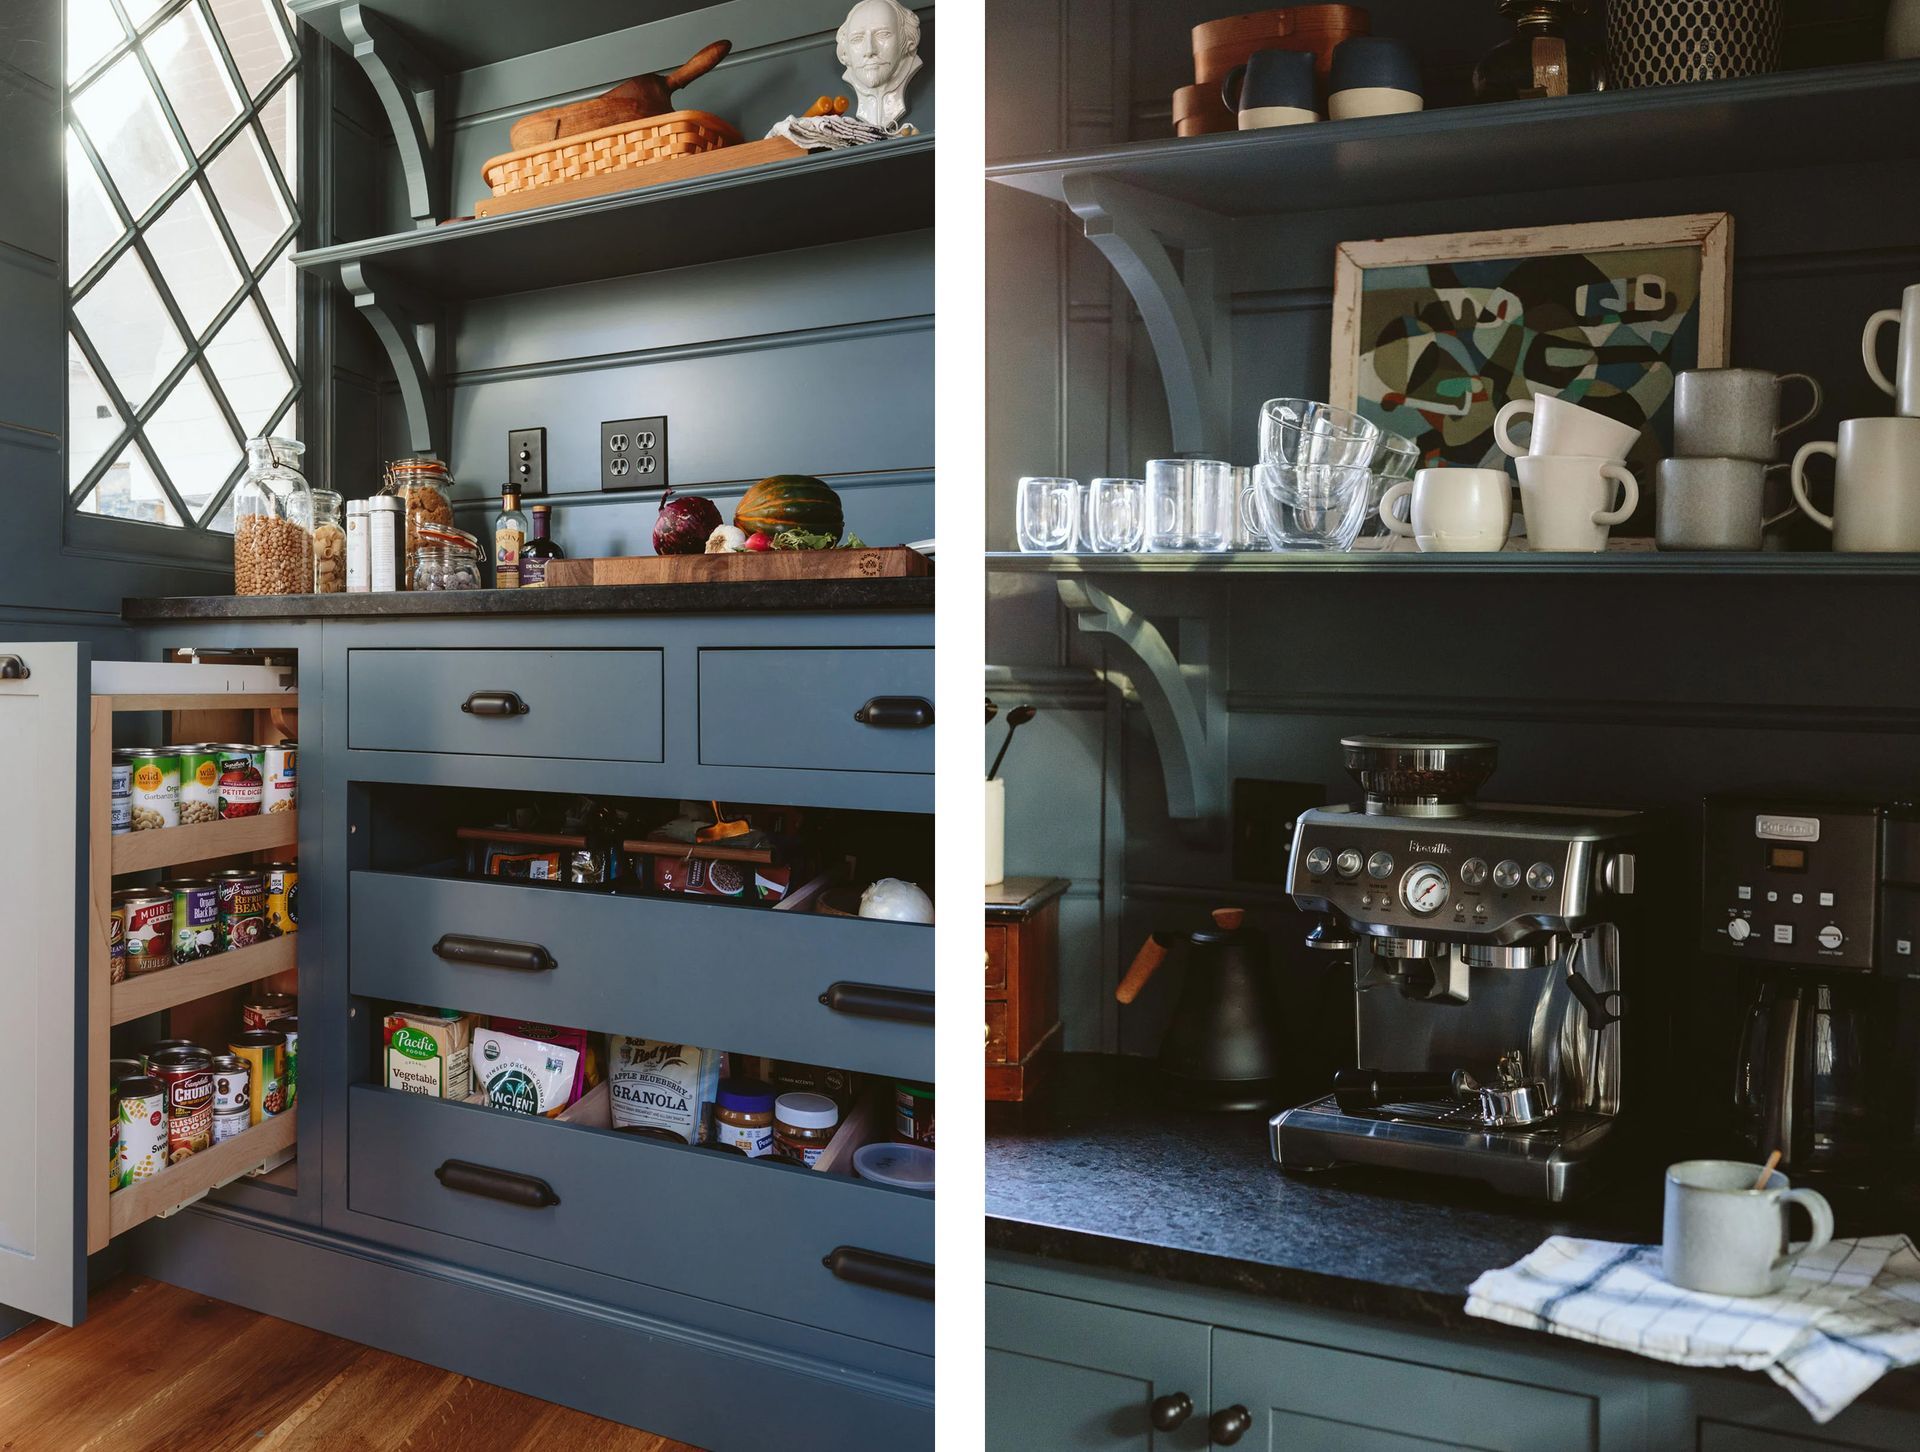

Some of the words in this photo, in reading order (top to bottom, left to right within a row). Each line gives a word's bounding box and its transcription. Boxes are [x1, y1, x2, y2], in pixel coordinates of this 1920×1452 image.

[141, 906, 165, 920] MUIR
[396, 1030, 434, 1051] Pacific
[392, 1068, 438, 1086] Vegetable
[486, 1061, 508, 1079] RINSED
[401, 1081, 429, 1096] Broth
[614, 1072, 638, 1081] APPLE
[640, 1074, 688, 1096] BLUEBERRY
[490, 1090, 534, 1112] ANCIENT
[612, 1085, 688, 1112] GRANOLA
